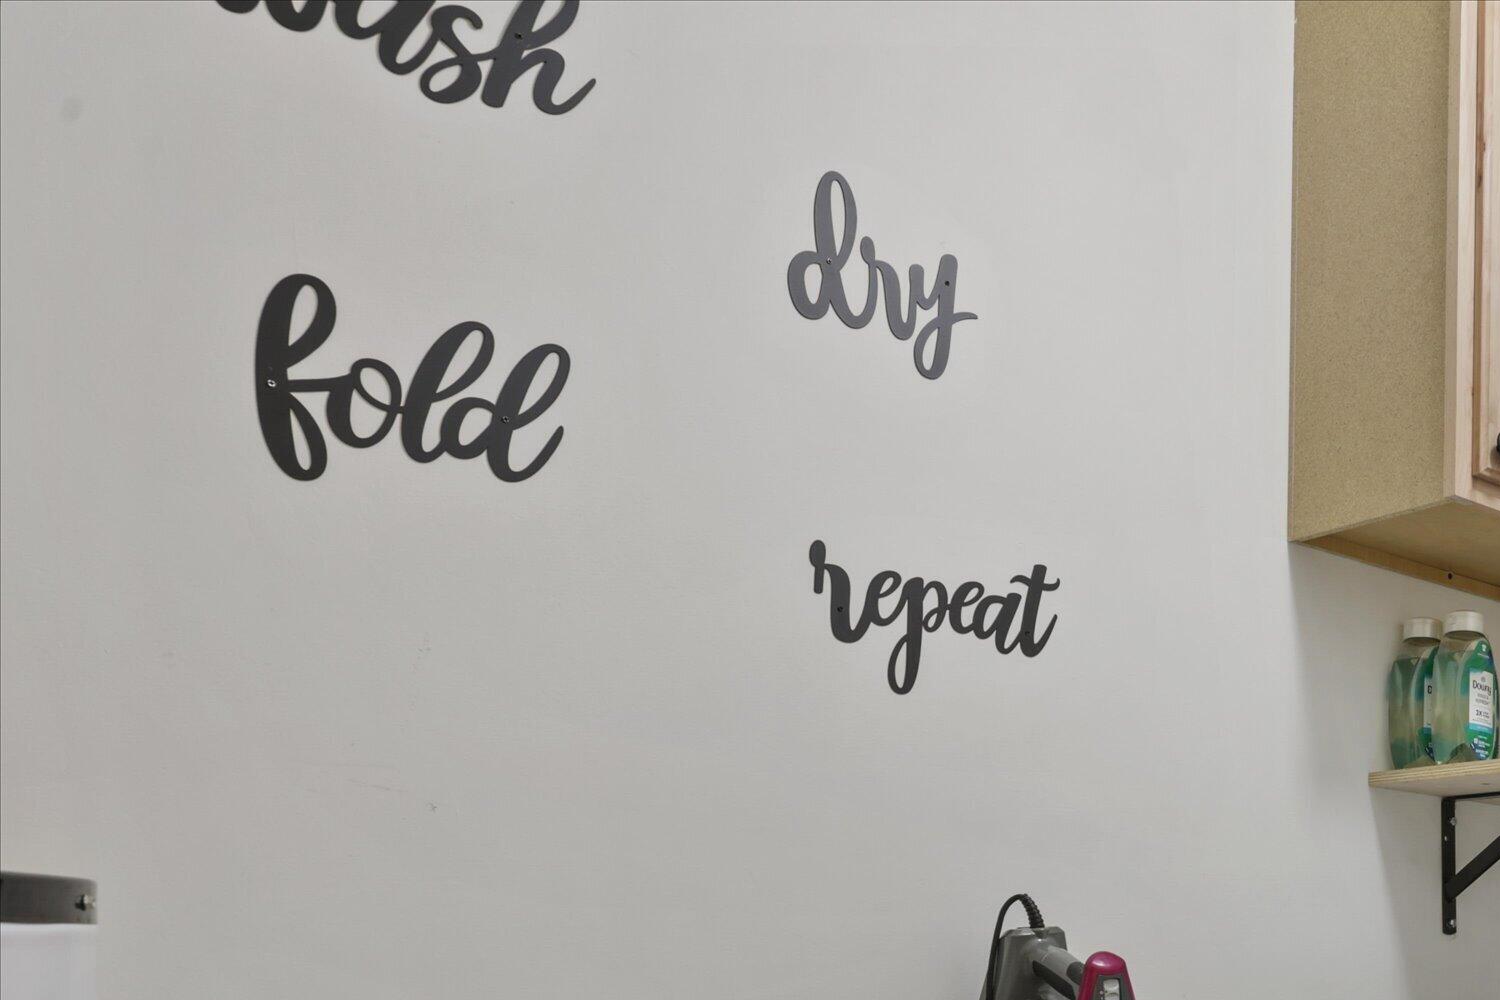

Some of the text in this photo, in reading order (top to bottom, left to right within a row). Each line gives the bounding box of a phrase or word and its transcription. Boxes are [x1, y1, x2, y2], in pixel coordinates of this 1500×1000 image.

[212, 0, 597, 116] ash
[786, 170, 979, 381] dry
[254, 273, 571, 483] fold
[808, 539, 1061, 695] repeat
[1473, 680, 1492, 697] Downy
